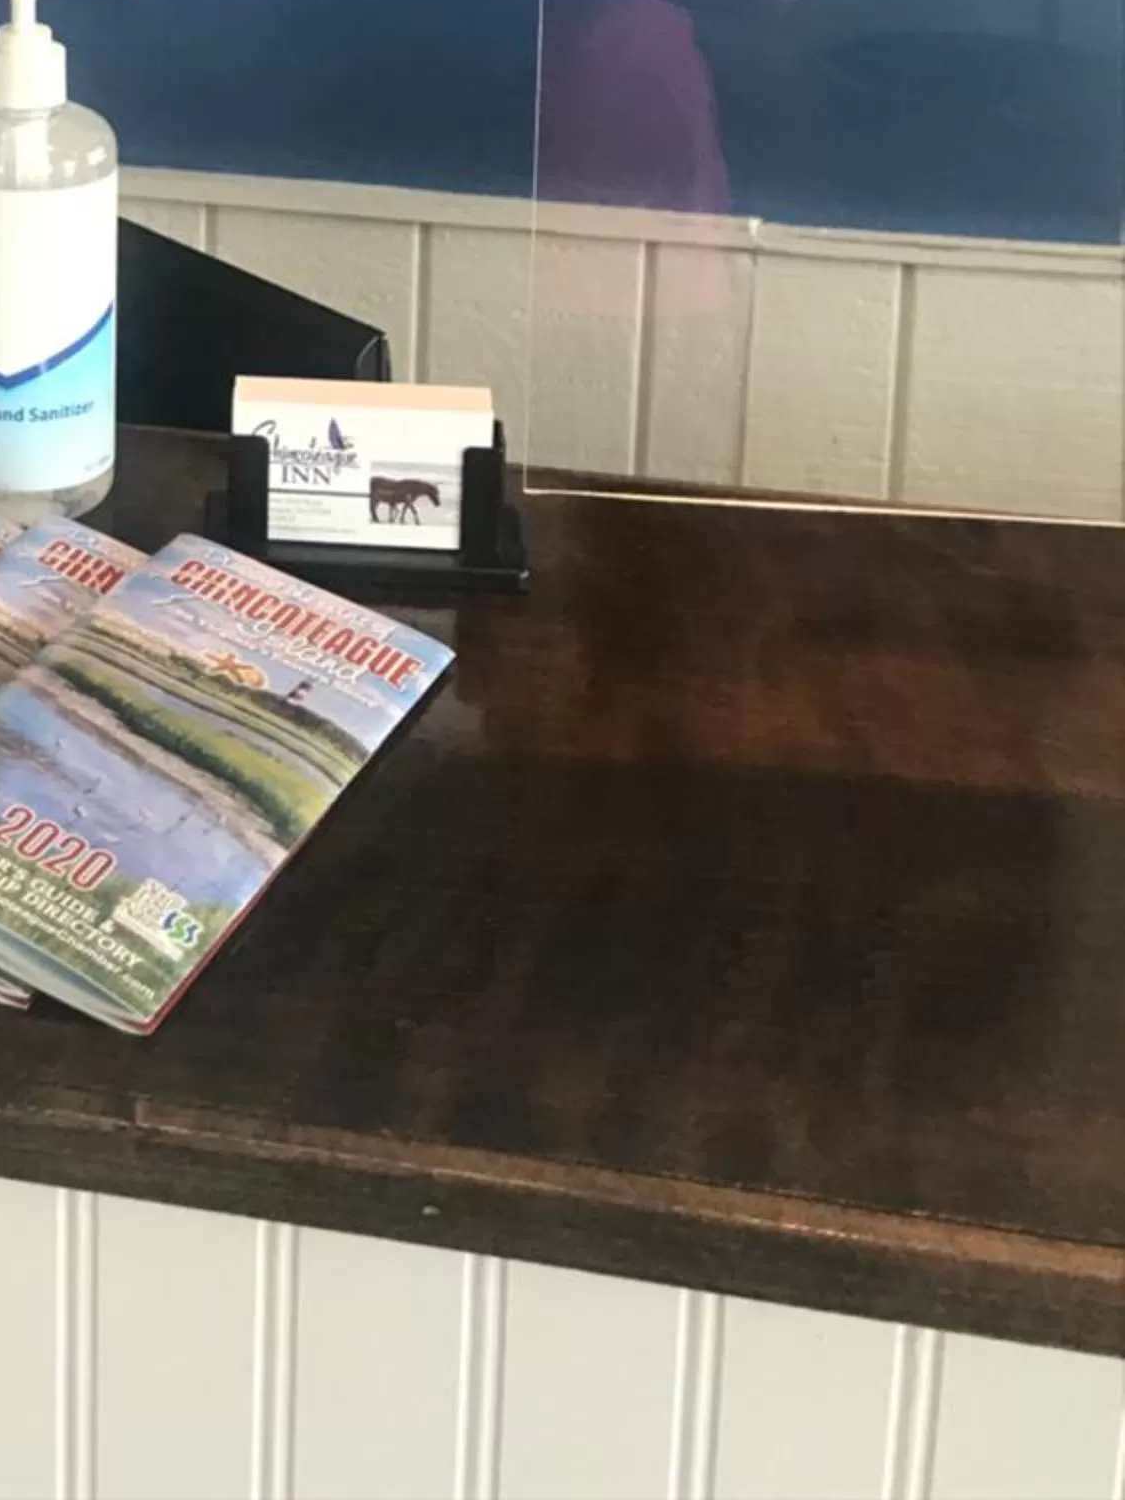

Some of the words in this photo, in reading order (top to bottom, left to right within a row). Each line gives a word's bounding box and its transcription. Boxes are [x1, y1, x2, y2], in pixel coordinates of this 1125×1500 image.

[28, 400, 96, 423] Sanitizer
[281, 464, 332, 485] INN
[171, 560, 425, 692] CHINCOTEAGUE
[29, 877, 100, 924] GUIDE
[22, 891, 146, 970] DIRECTORY
